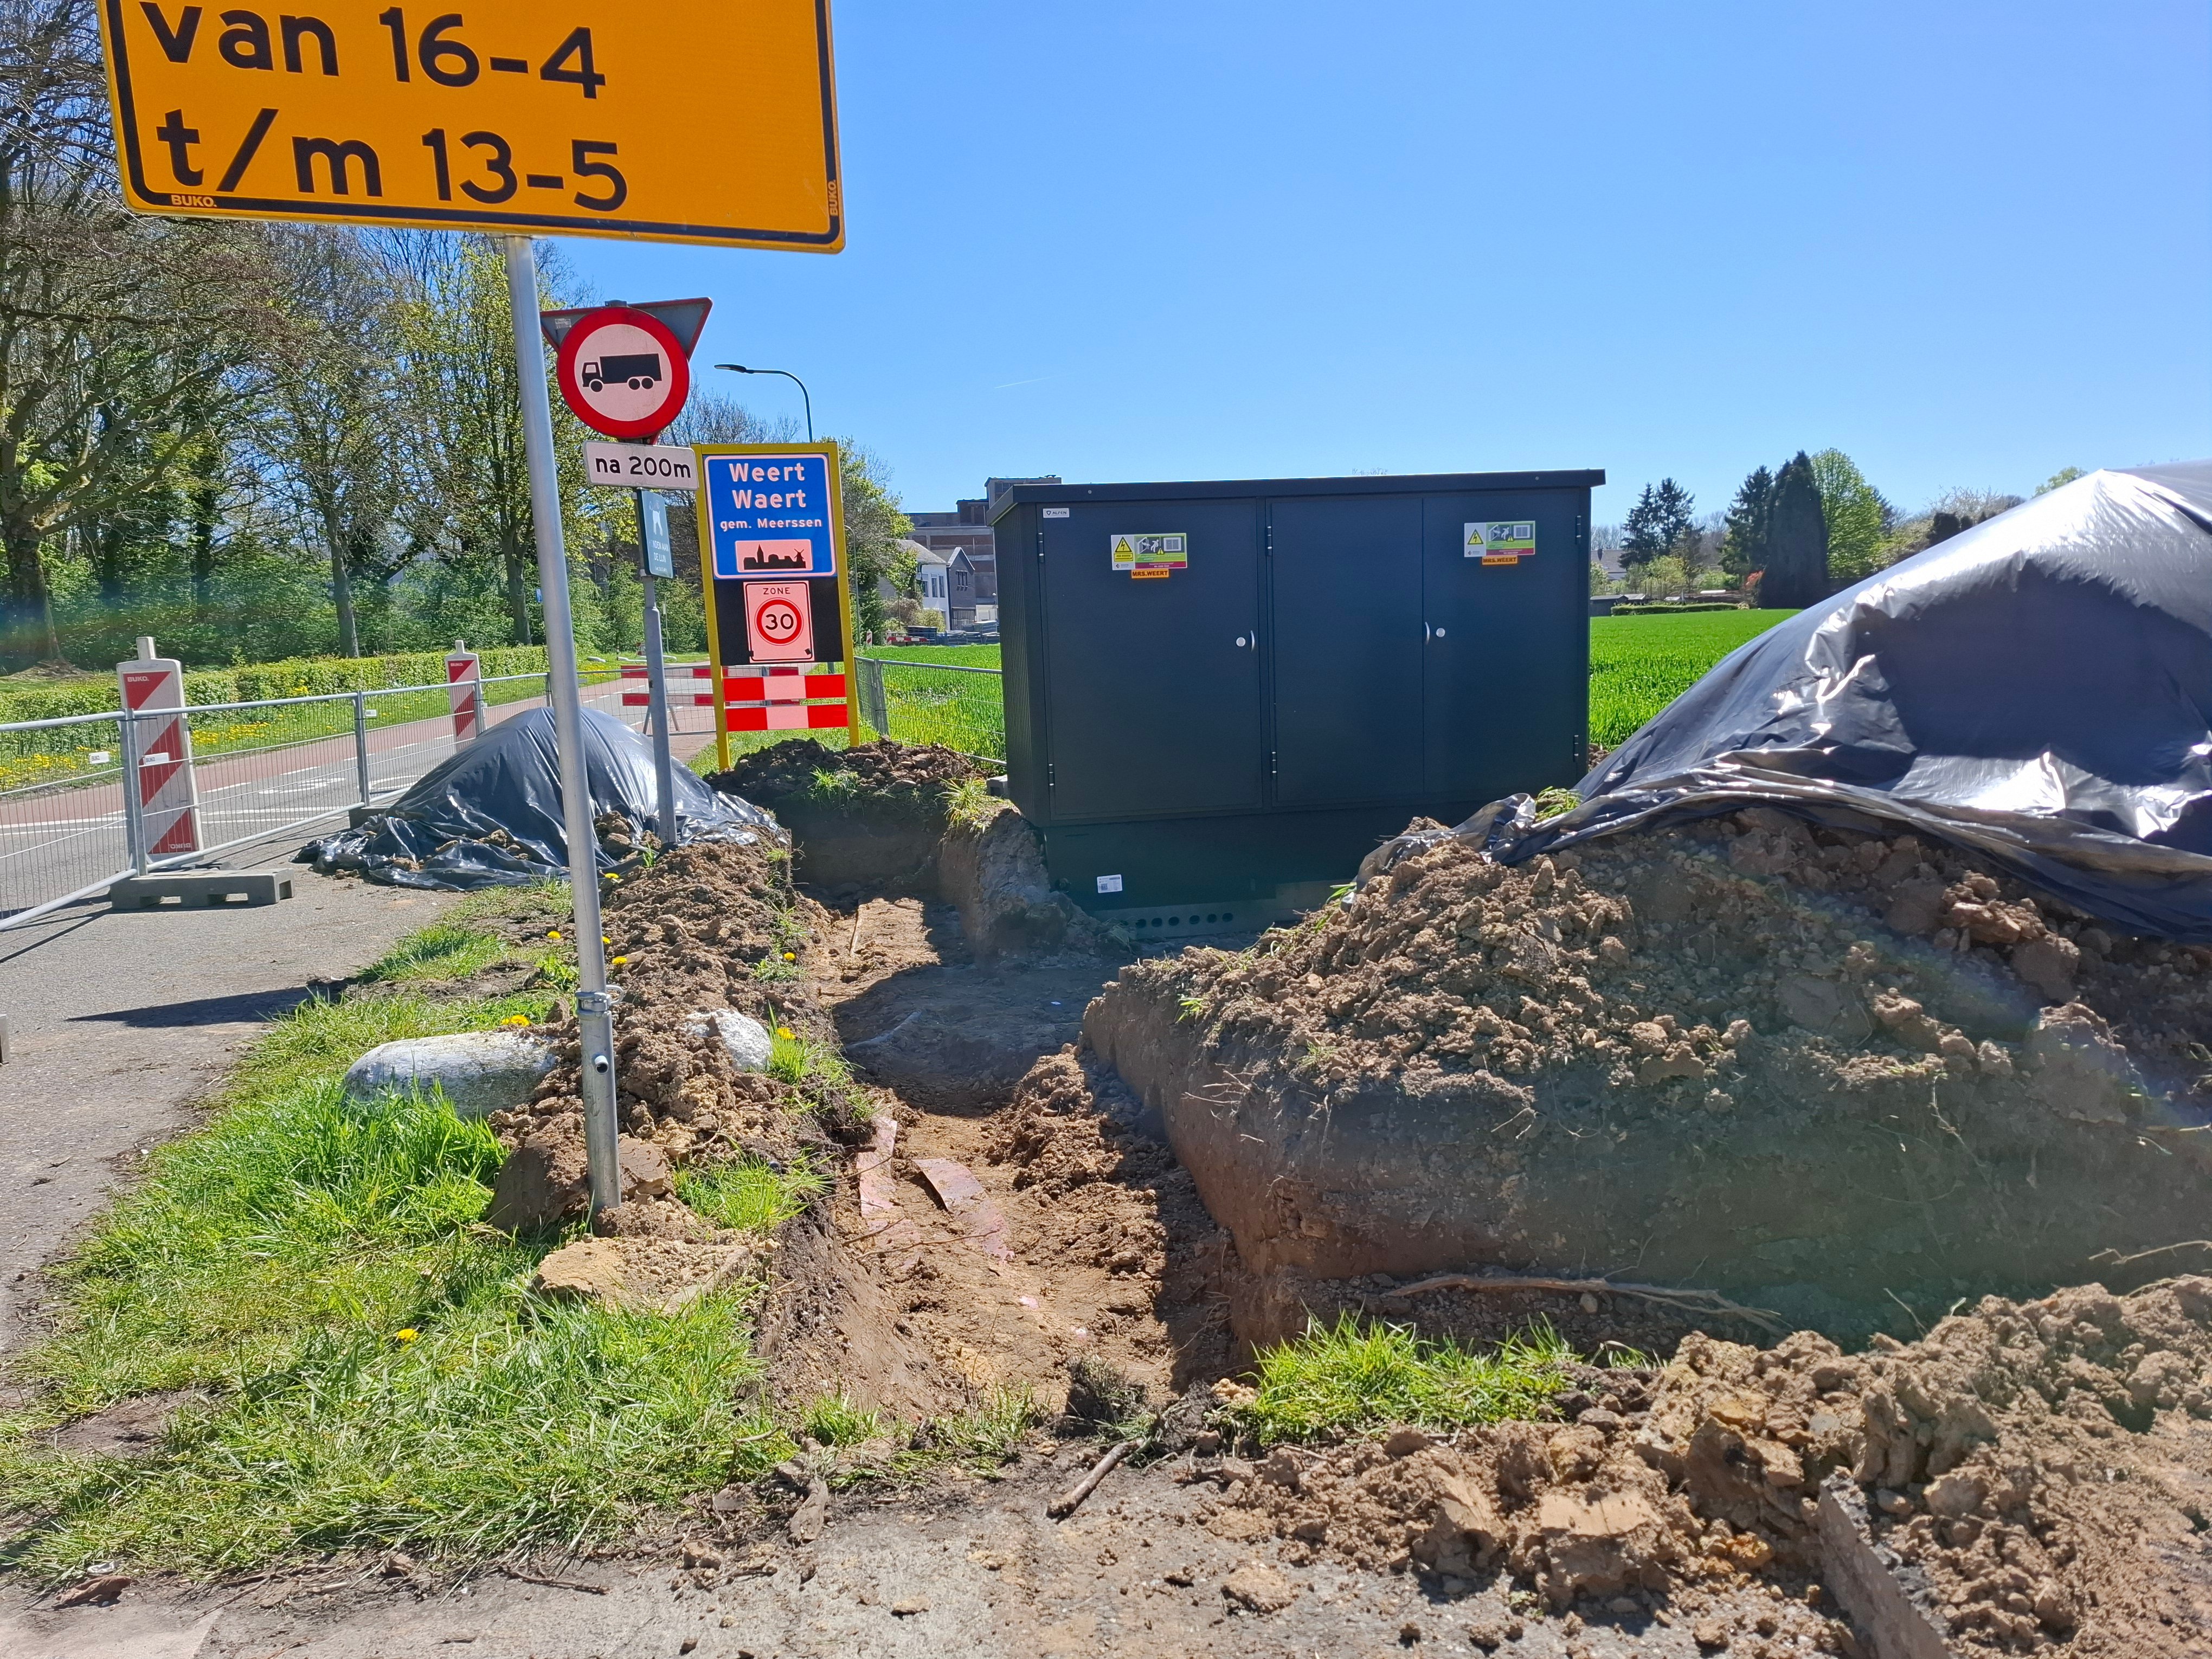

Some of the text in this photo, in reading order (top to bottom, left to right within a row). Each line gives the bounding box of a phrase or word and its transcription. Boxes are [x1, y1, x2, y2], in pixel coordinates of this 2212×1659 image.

[139, 2, 607, 100] van 16-4
[157, 109, 628, 212] t/m 13-5
[595, 456, 691, 478] na 200m
[729, 462, 805, 482] Weert
[732, 490, 806, 509] Waert
[720, 518, 822, 532] gem. Meerssen
[649, 540, 661, 549] NDEN
[765, 613, 794, 631] 30
